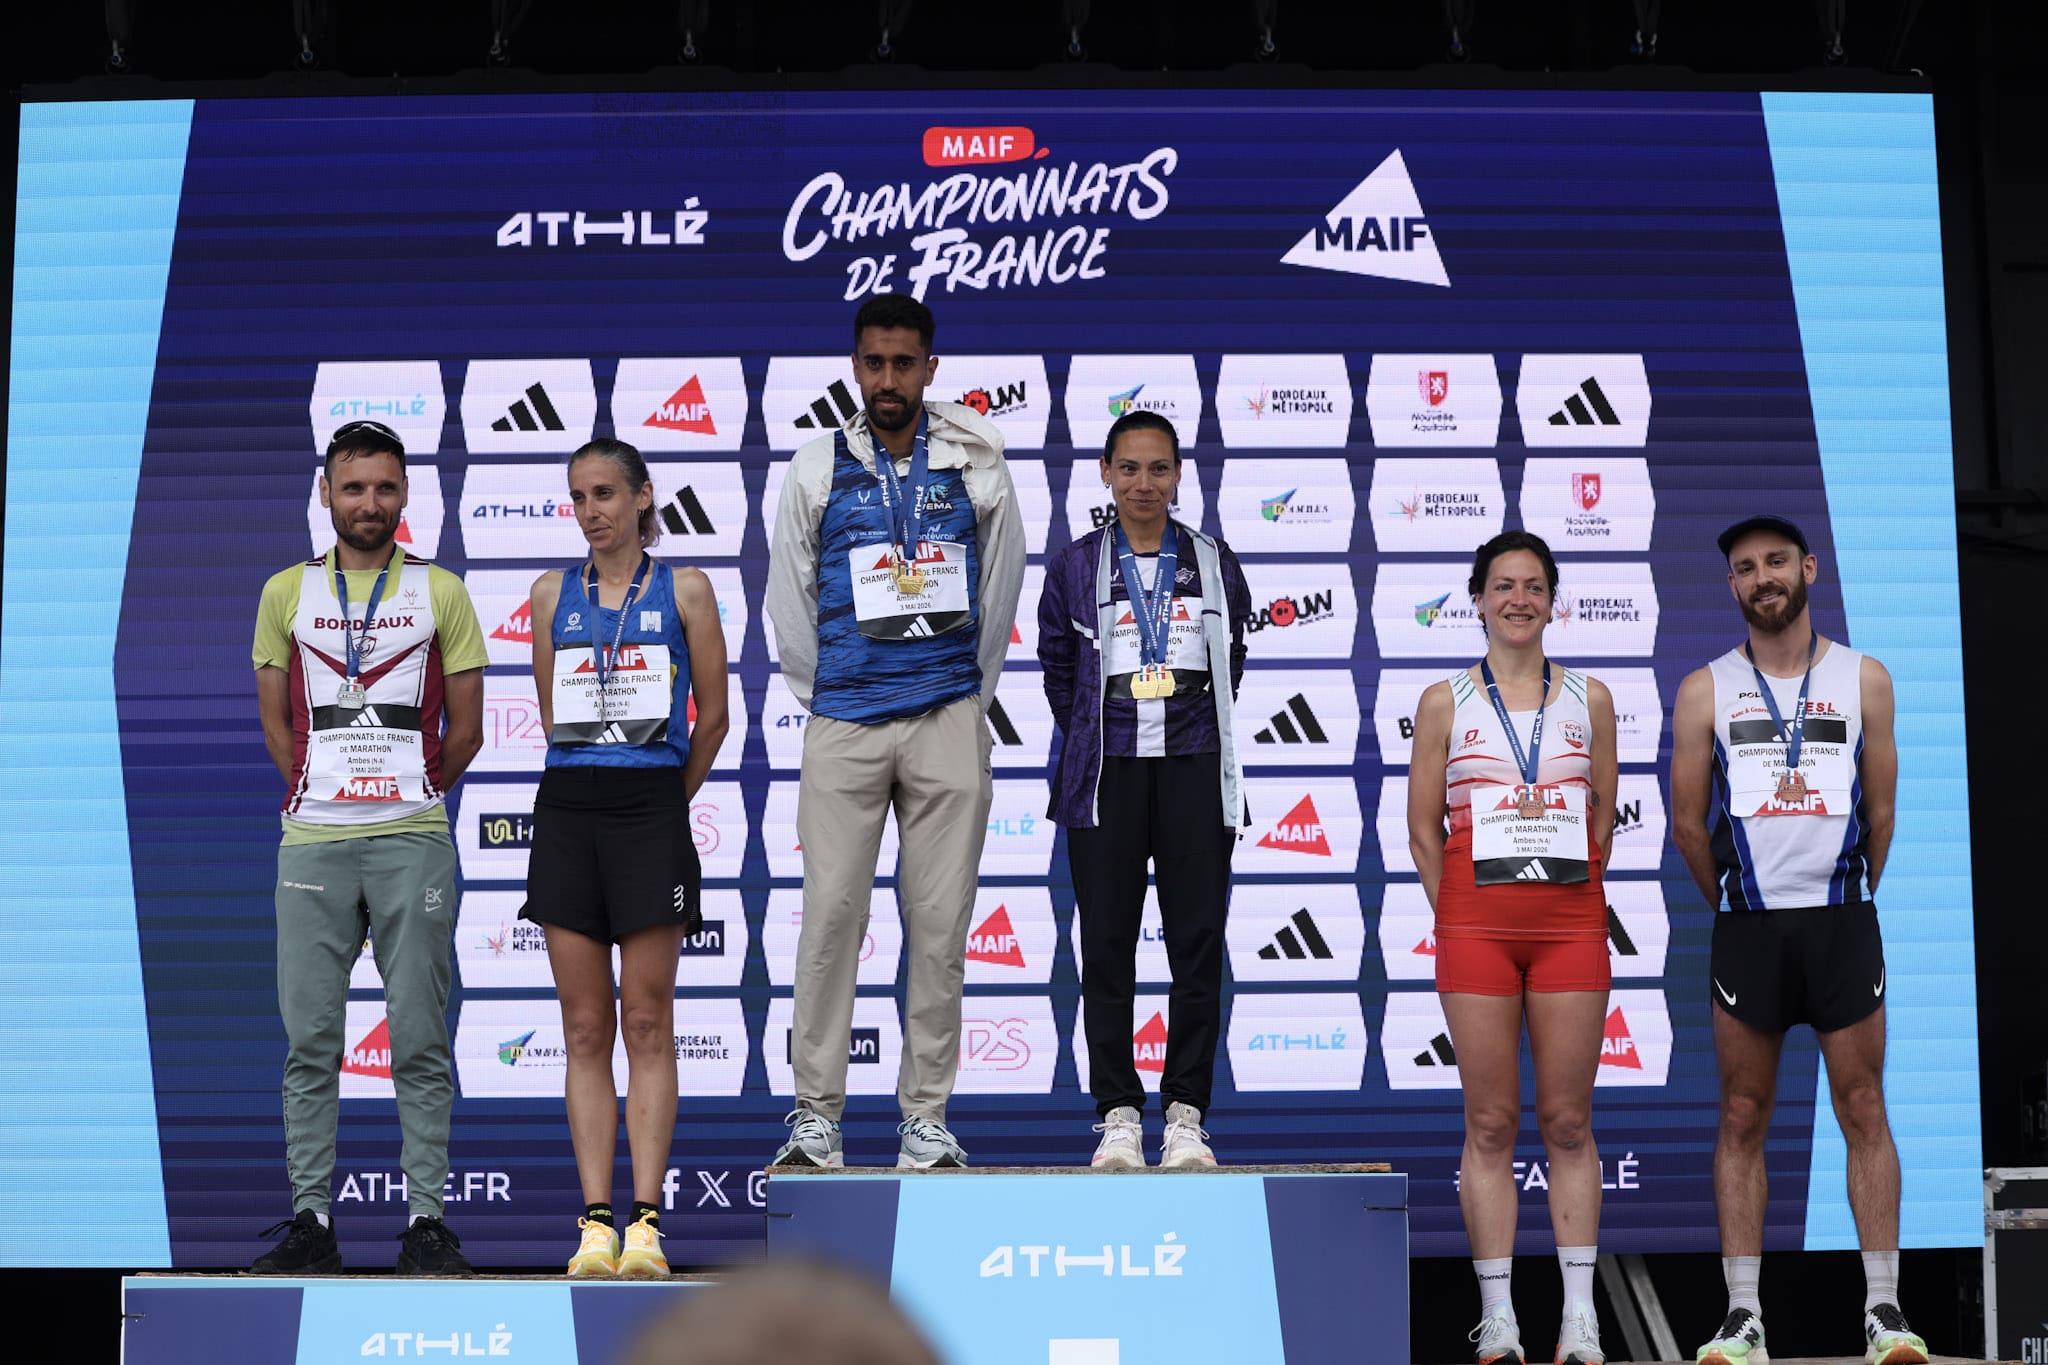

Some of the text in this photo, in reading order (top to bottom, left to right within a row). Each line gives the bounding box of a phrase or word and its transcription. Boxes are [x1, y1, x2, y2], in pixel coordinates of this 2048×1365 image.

[942, 135, 1015, 159] MAIF
[781, 146, 1178, 262] CHAMPIONNATS
[497, 197, 708, 247] ATHLÉ
[1315, 216, 1429, 252] MAIF
[844, 227, 1110, 303] DE FRANCE
[1272, 390, 1328, 401] BORDEAUX
[330, 393, 427, 416] ATHLÉ
[1272, 400, 1334, 414] MÉTROPOLE
[657, 403, 710, 423] MAIF
[878, 474, 890, 507] ATHLÉ
[913, 485, 925, 520] ATHLÉ
[1425, 493, 1480, 505] BORDEAUX
[473, 499, 555, 517] ATHLÉ
[1425, 502, 1487, 517] MÉTROPOLE
[932, 566, 959, 576] FRANCE
[1162, 591, 1171, 624] ATHLÉ
[1579, 599, 1634, 610] BORDEAUX
[1579, 609, 1641, 623] MÉTROPOLE
[314, 616, 415, 632] BORDEAUX
[1176, 625, 1201, 634] FRANCE
[1129, 640, 1139, 648] DE
[561, 677, 620, 687] CHAMPIONATS
[631, 674, 662, 683] FRANCE
[319, 733, 375, 744] CHAMPIONNATS
[387, 733, 415, 744] FRANCE
[350, 745, 392, 754] MARATHON
[1810, 747, 1841, 756] FRANCE
[348, 757, 370, 765] Ambes
[344, 780, 398, 798] MAIF
[1552, 815, 1579, 825] FRANCE
[1270, 824, 1325, 843] MAIF
[1515, 825, 1558, 833] MARATHON
[513, 927, 545, 938] BORDE
[513, 938, 547, 951] MÉTRO
[966, 935, 1018, 954] MAIF
[674, 1036, 721, 1047] ORDEAUX
[1248, 1026, 1347, 1051] ATHLÉ
[1601, 1037, 1634, 1055] AIF
[675, 1046, 729, 1060] ÉTROPOLE
[337, 1172, 512, 1203] ATHE.FR
[980, 1231, 1187, 1278] ATHLÉ
[361, 1322, 513, 1357] ATHLÉ
